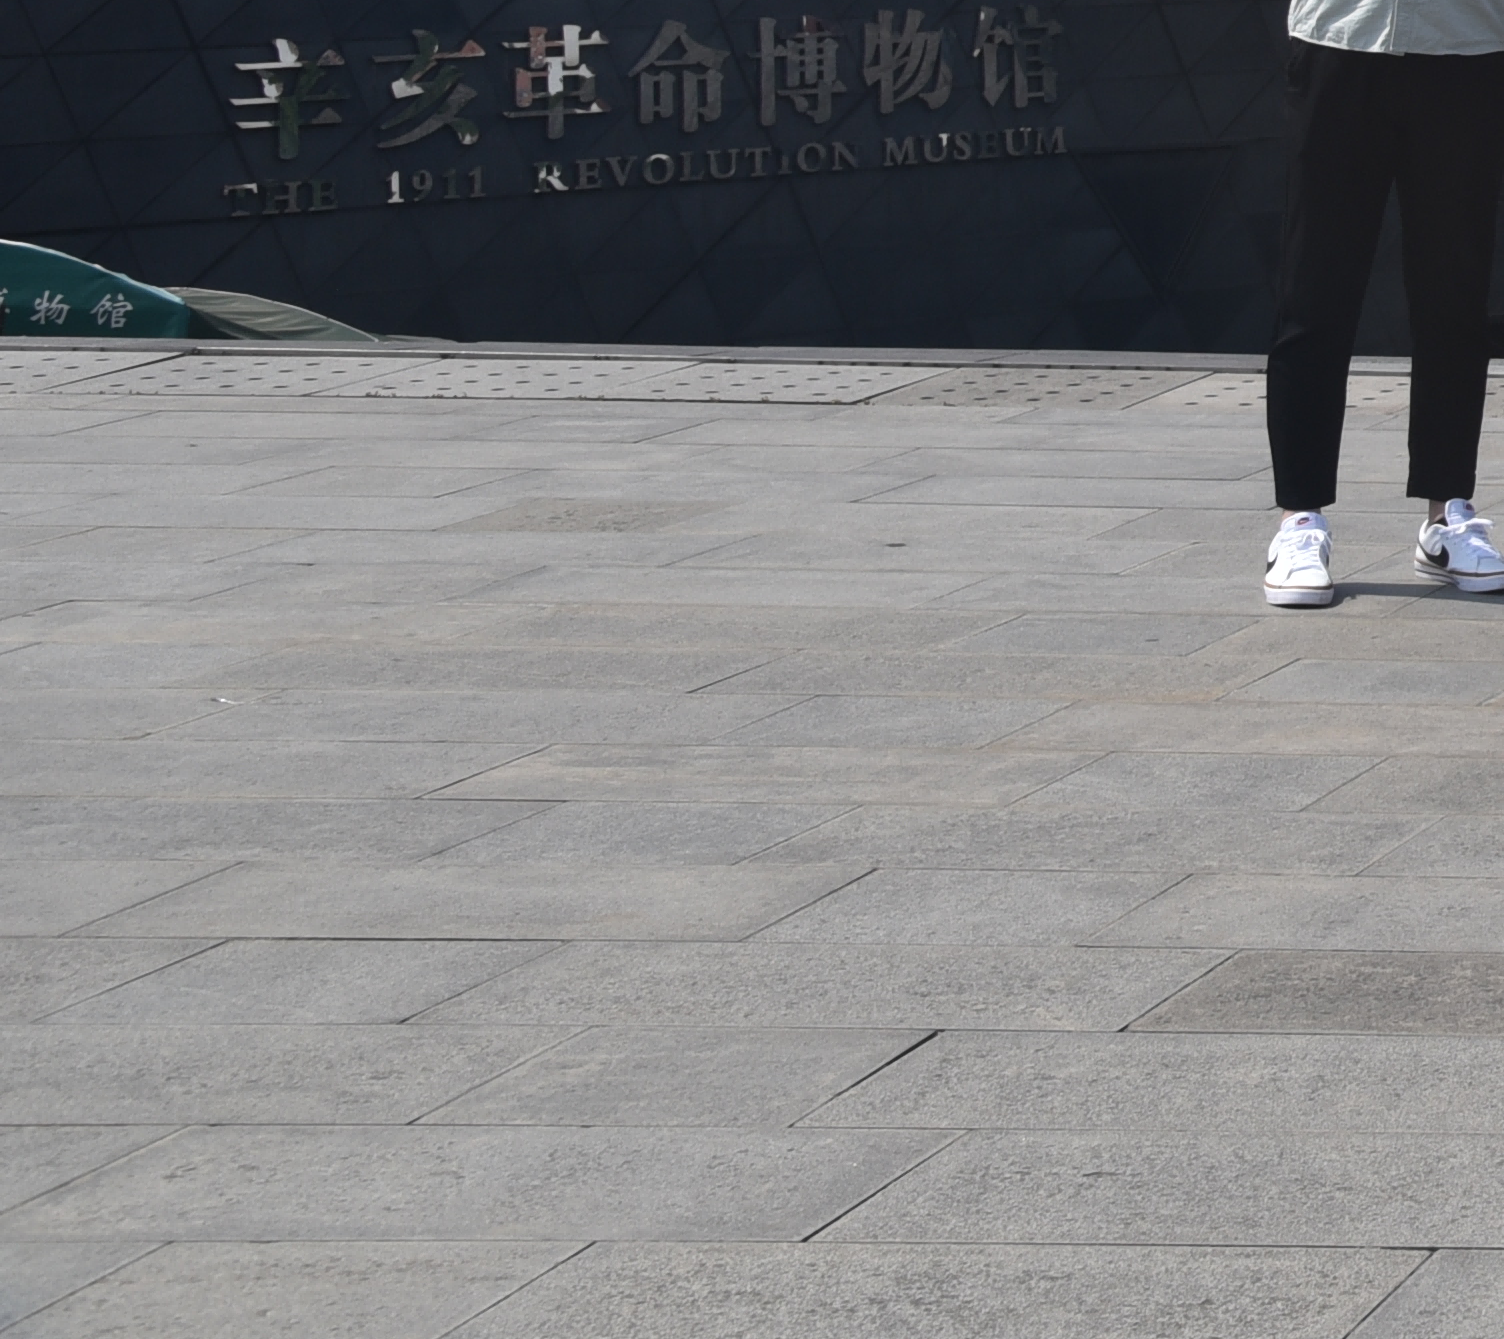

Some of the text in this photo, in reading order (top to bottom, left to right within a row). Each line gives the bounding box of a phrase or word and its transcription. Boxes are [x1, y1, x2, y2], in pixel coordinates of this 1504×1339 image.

[229, 5, 1064, 160] 辛亥革命博物馆
[223, 126, 1067, 217] THE 1911 REVOLUTION MUSEUM
[0, 288, 133, 328] 物馆
